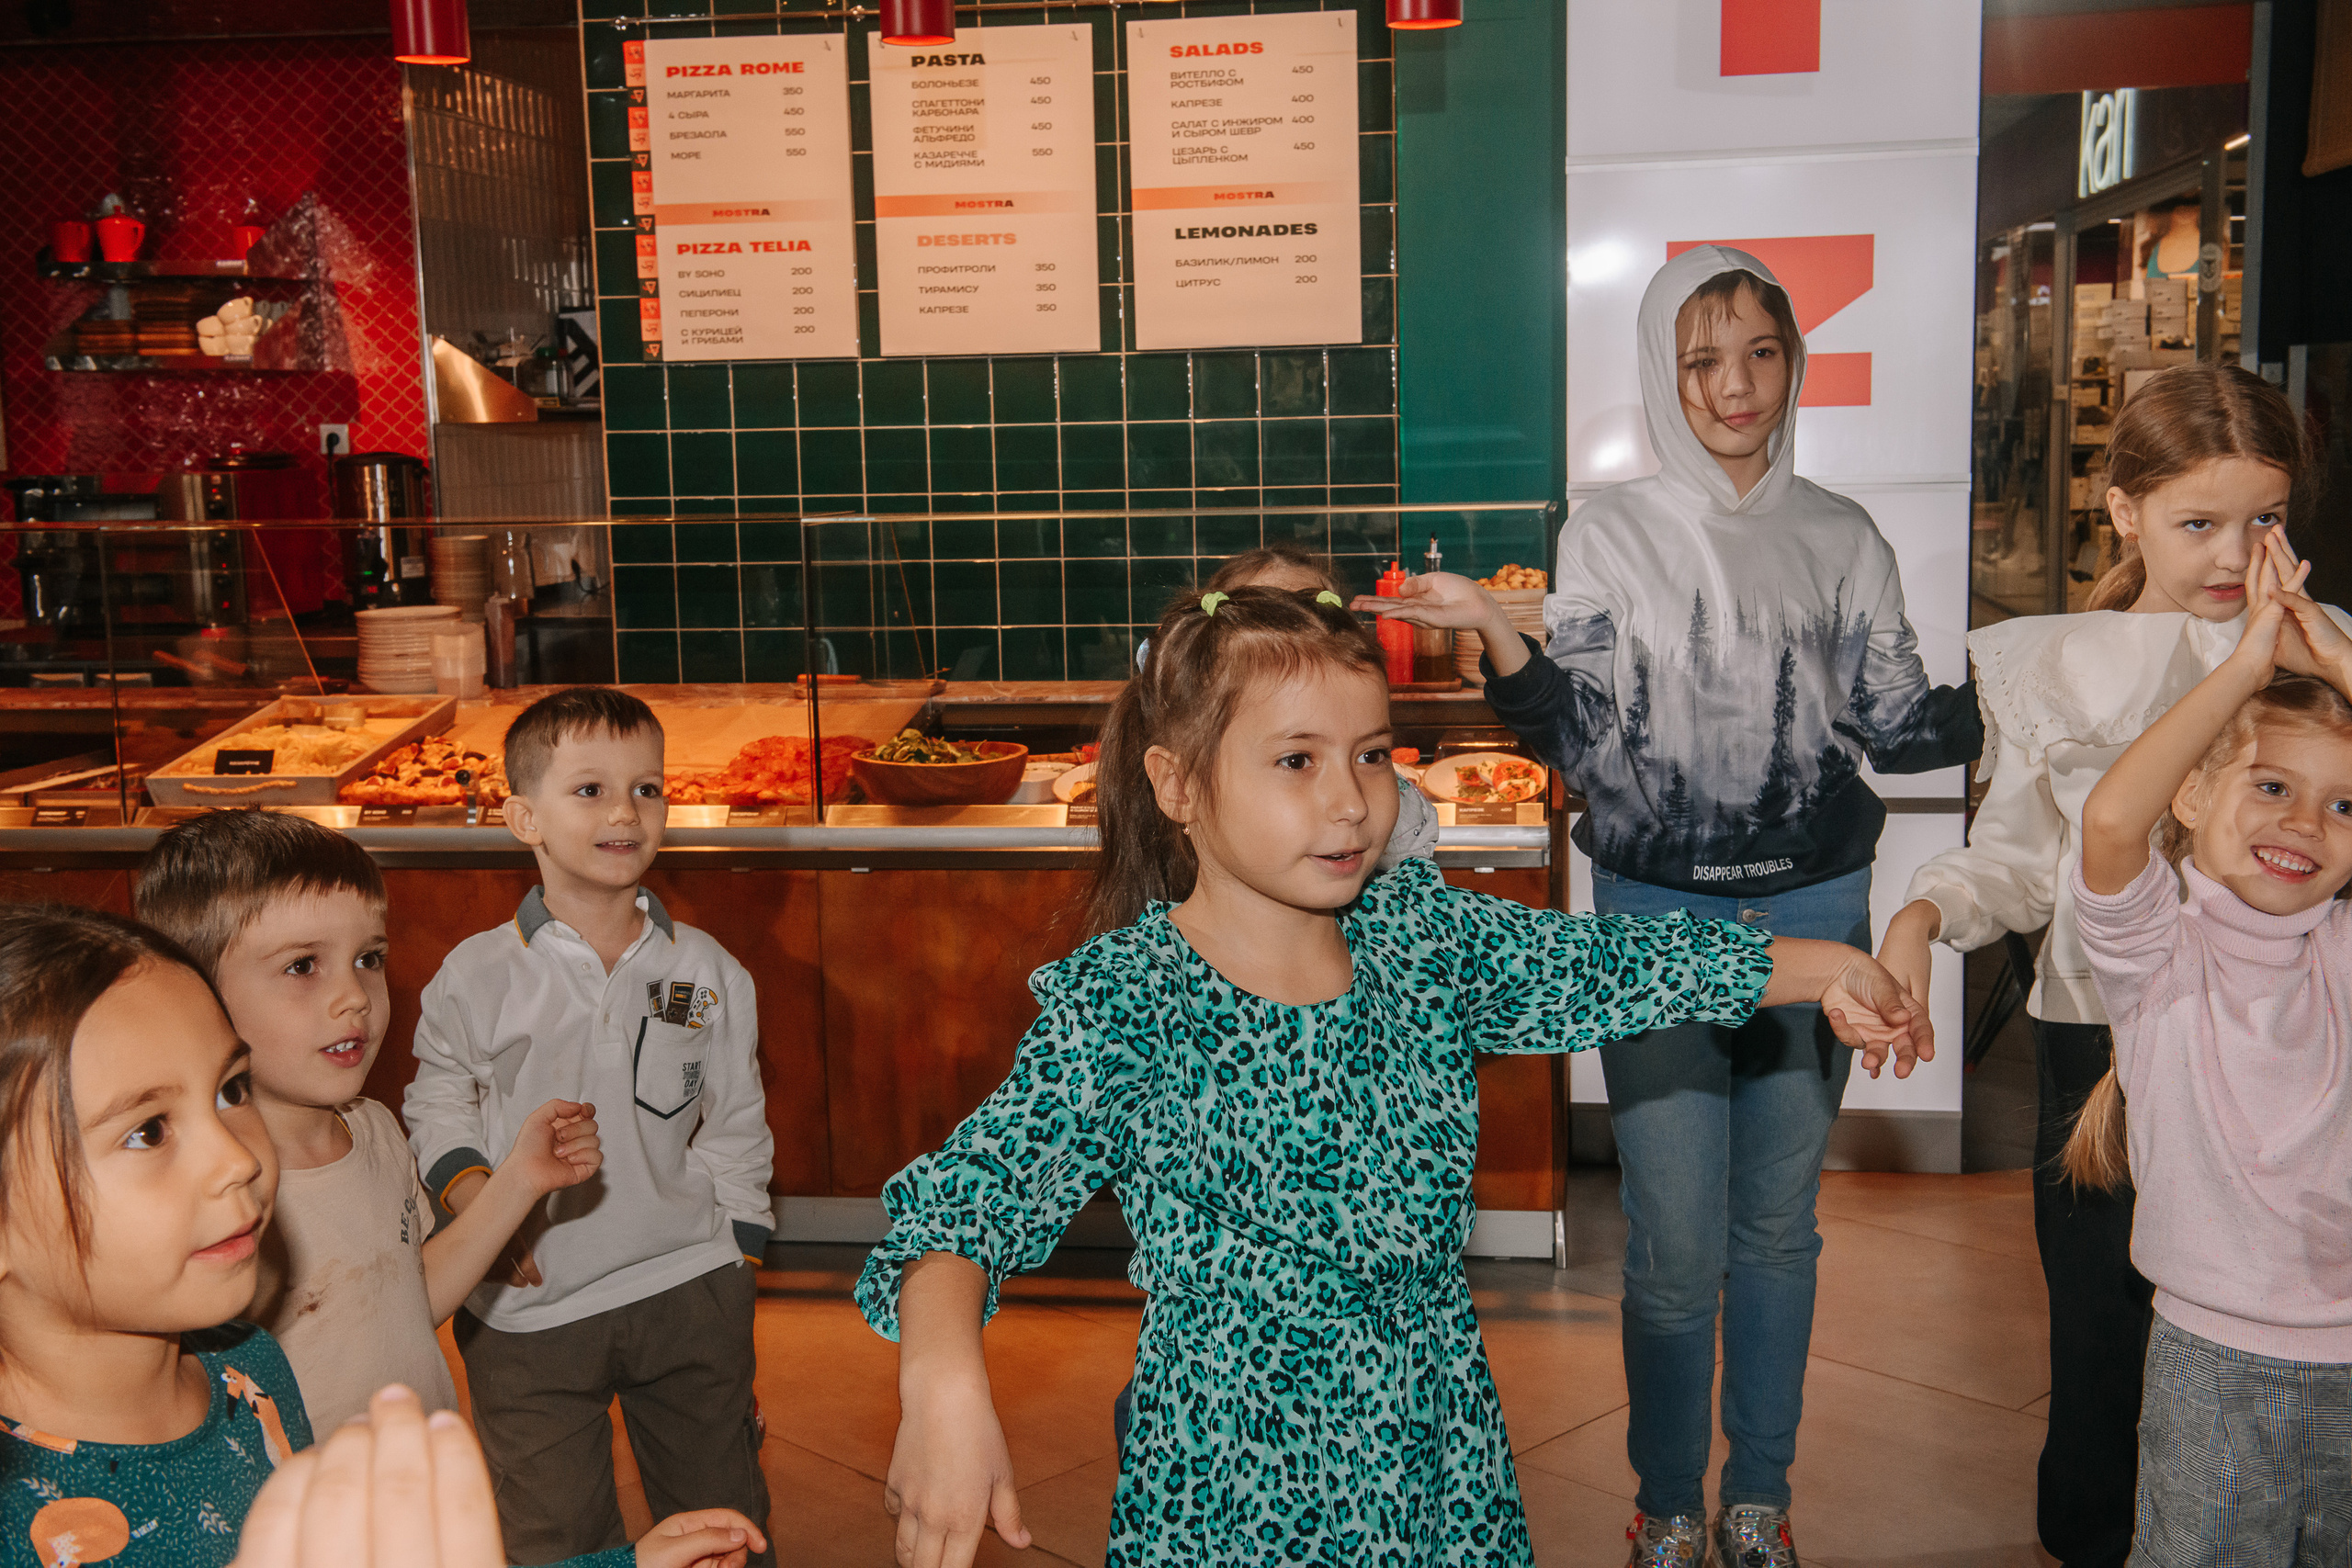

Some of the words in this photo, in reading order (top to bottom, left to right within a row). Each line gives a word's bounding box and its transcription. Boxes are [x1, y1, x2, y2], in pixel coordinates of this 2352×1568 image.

[1170, 42, 1263, 58] SALADS
[911, 53, 986, 67] PASTA
[666, 64, 732, 77] PIZZA
[741, 62, 804, 74] ROME
[1170, 70, 1225, 79] ВИТЕЛЛО
[1292, 65, 1314, 73] 450
[911, 79, 979, 89] БОЛОНЬЕЗЕ
[1030, 76, 1051, 85] 450
[1170, 78, 1244, 88] РОСТБИФОМ
[667, 89, 730, 98] МАРГАРИТА
[783, 87, 803, 96] 350
[912, 98, 985, 108] СПАГЕТТОНИ
[1171, 98, 1222, 108] КАПРЕЗЕ
[1292, 95, 1314, 103] 400
[677, 111, 709, 119] СЫРА
[784, 107, 805, 116] 450
[912, 107, 979, 117] КАРБОНАРА
[913, 125, 974, 134] ФЕТУЧИНИ
[1031, 122, 1052, 130] 450
[1171, 120, 1207, 130] САЛАТ
[1223, 117, 1283, 127] ИНЖИРОМ
[1292, 115, 1315, 123] 400
[670, 130, 727, 140] БРЕЗАОЛА
[785, 128, 806, 136] 550
[913, 134, 975, 142] АЛЬФРЕДО
[1183, 129, 1227, 138] СЫРОМ
[1230, 127, 1261, 136] ШЕВР
[671, 152, 701, 160] МОРЕ
[786, 148, 807, 156] 550
[914, 151, 978, 159] КАЗАРЕЧЧЕ
[1032, 148, 1053, 156] 550
[1172, 147, 1216, 156] ЦЕЗАРЬ
[1294, 141, 1315, 150] 450
[925, 160, 985, 168] МИДИЯМИ
[1172, 154, 1248, 164] ЦЫПЛЕНКОМ
[1214, 191, 1274, 200] MOSTRA
[955, 200, 1013, 209] MOSTRA
[712, 209, 770, 218] MOSTRA
[1175, 223, 1317, 240] LEMONADES
[917, 233, 1016, 247] DESERTS
[677, 243, 742, 254] PIZZA
[750, 241, 811, 253] TELIA
[1175, 256, 1279, 267] БАЗИЛИК/ЛИМОН
[1295, 254, 1317, 263] 200
[695, 270, 725, 278] SOHO
[791, 267, 812, 276] 200
[918, 265, 996, 274] ПРОФИТРОЛИ
[1176, 278, 1220, 288] ЦИТРУС
[679, 289, 741, 298] СИЦИЛИЕЦ
[792, 287, 813, 295] 200
[919, 286, 978, 294] ТИРАМИСУ
[680, 309, 739, 318] ПЕПЕРОНИ
[692, 326, 742, 335] КУРИЦЕЙ
[795, 325, 815, 333] 200
[692, 336, 743, 344] ГРИБАМИ
[1693, 865, 1744, 881] DISAPPEAR
[1744, 858, 1793, 877] TROUBLES
[683, 1061, 701, 1071] START
